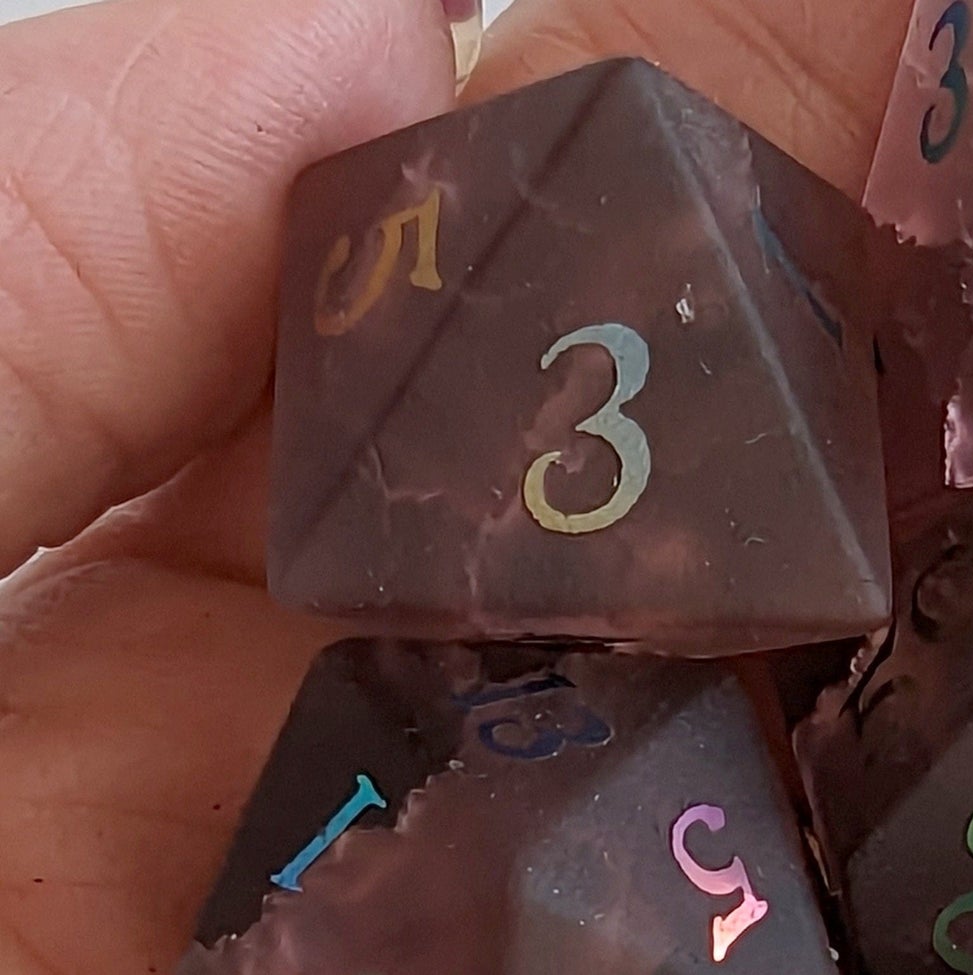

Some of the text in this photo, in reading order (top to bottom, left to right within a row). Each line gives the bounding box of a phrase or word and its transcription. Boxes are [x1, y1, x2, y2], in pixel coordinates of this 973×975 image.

[918, 0, 971, 165] 3
[313, 186, 444, 337] 5
[523, 322, 653, 535] 3
[269, 773, 388, 892] 1
[671, 803, 769, 962] 5
